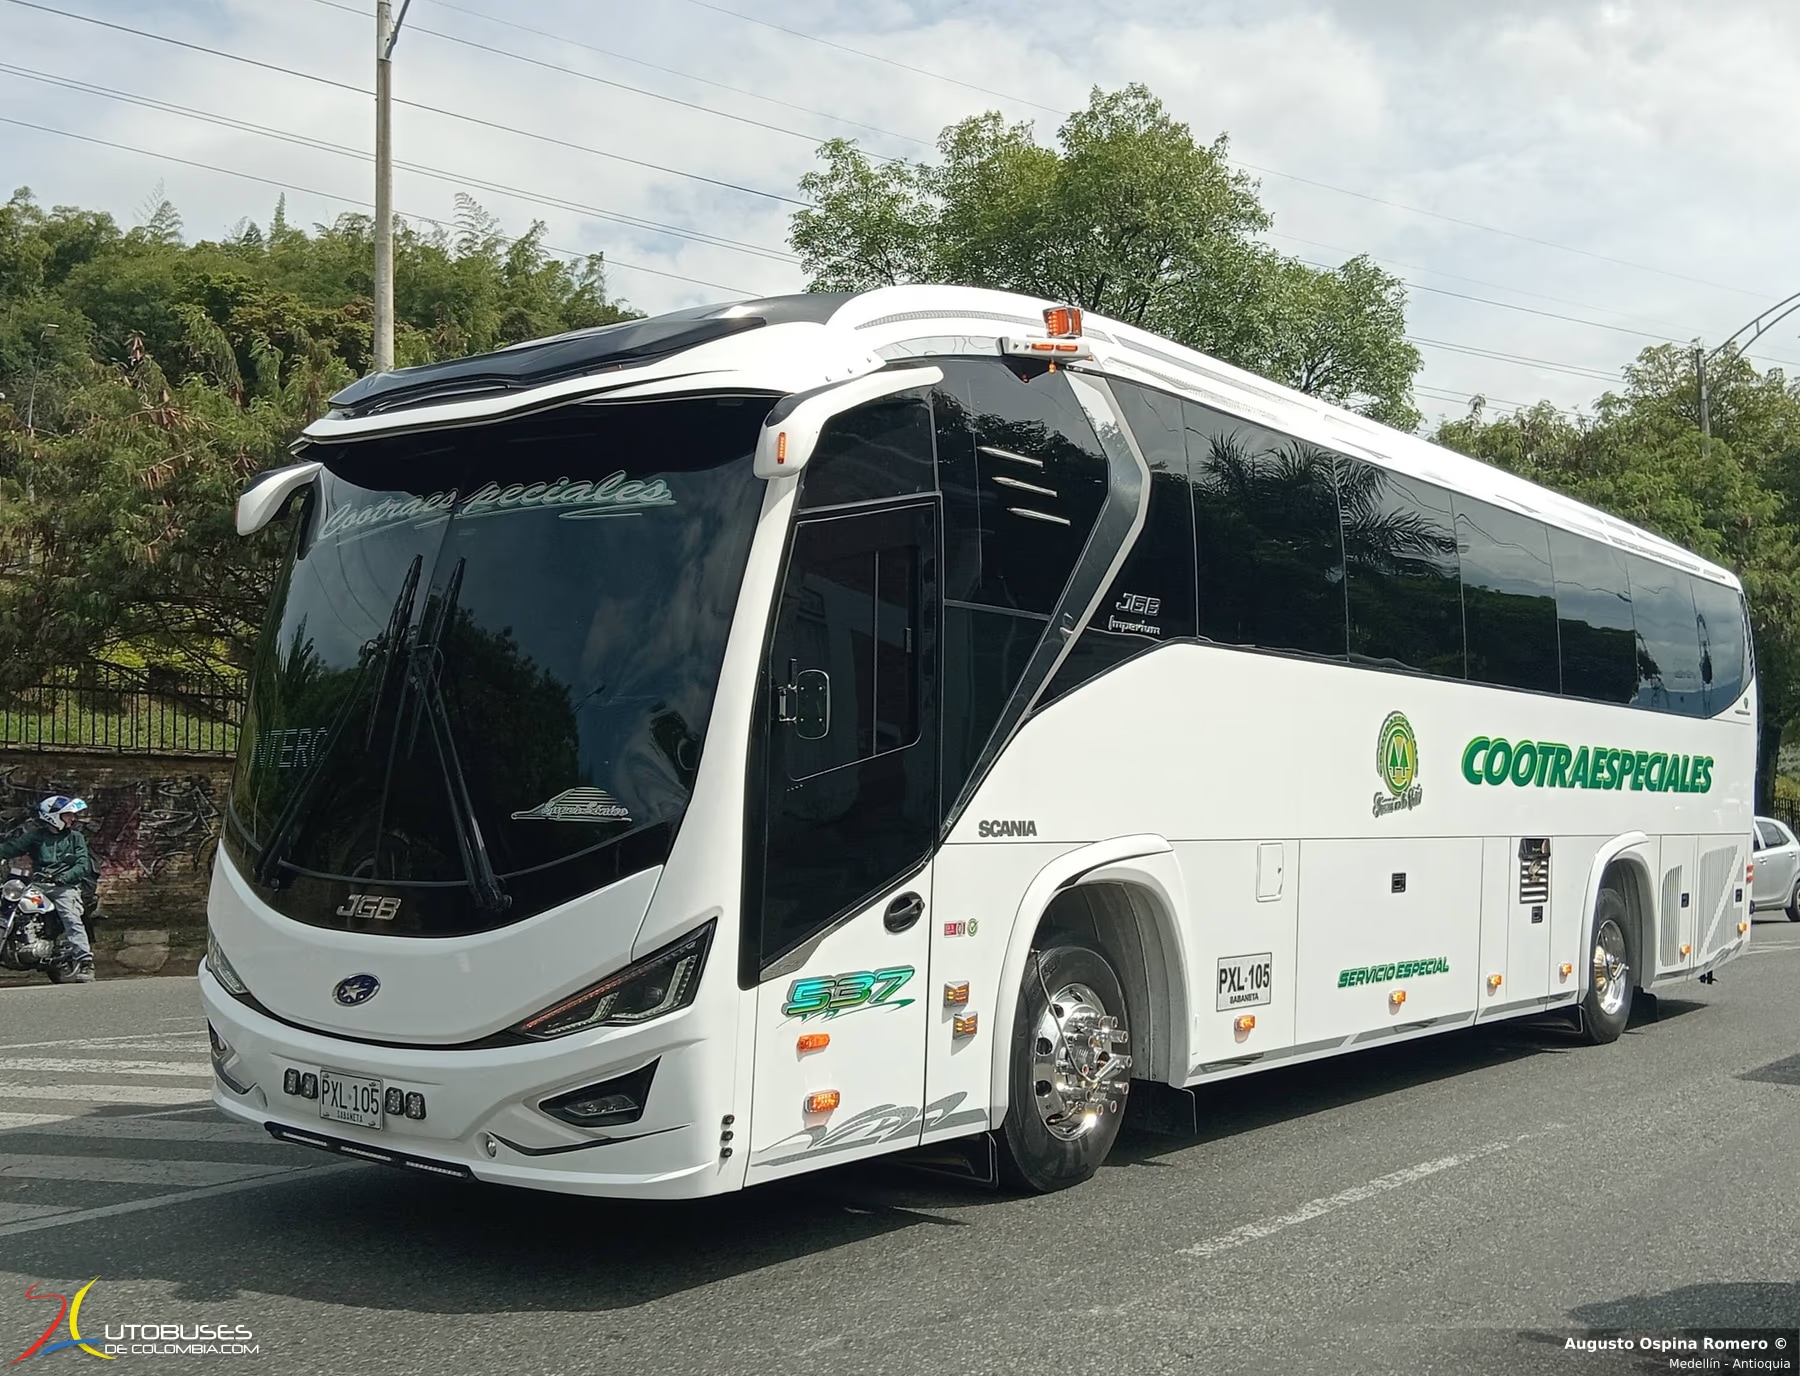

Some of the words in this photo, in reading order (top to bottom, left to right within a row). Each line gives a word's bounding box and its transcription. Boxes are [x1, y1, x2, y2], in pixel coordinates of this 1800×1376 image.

[1115, 592, 1161, 616] JGB
[1108, 615, 1161, 635] Imperium
[1461, 736, 1714, 793] COOTRAESPECIALES
[978, 820, 1038, 837] SCANIA
[336, 894, 402, 920] JGB
[1338, 963, 1396, 988] SERVICIO
[1396, 957, 1449, 979] ESPECIAL
[781, 965, 915, 1017] 537
